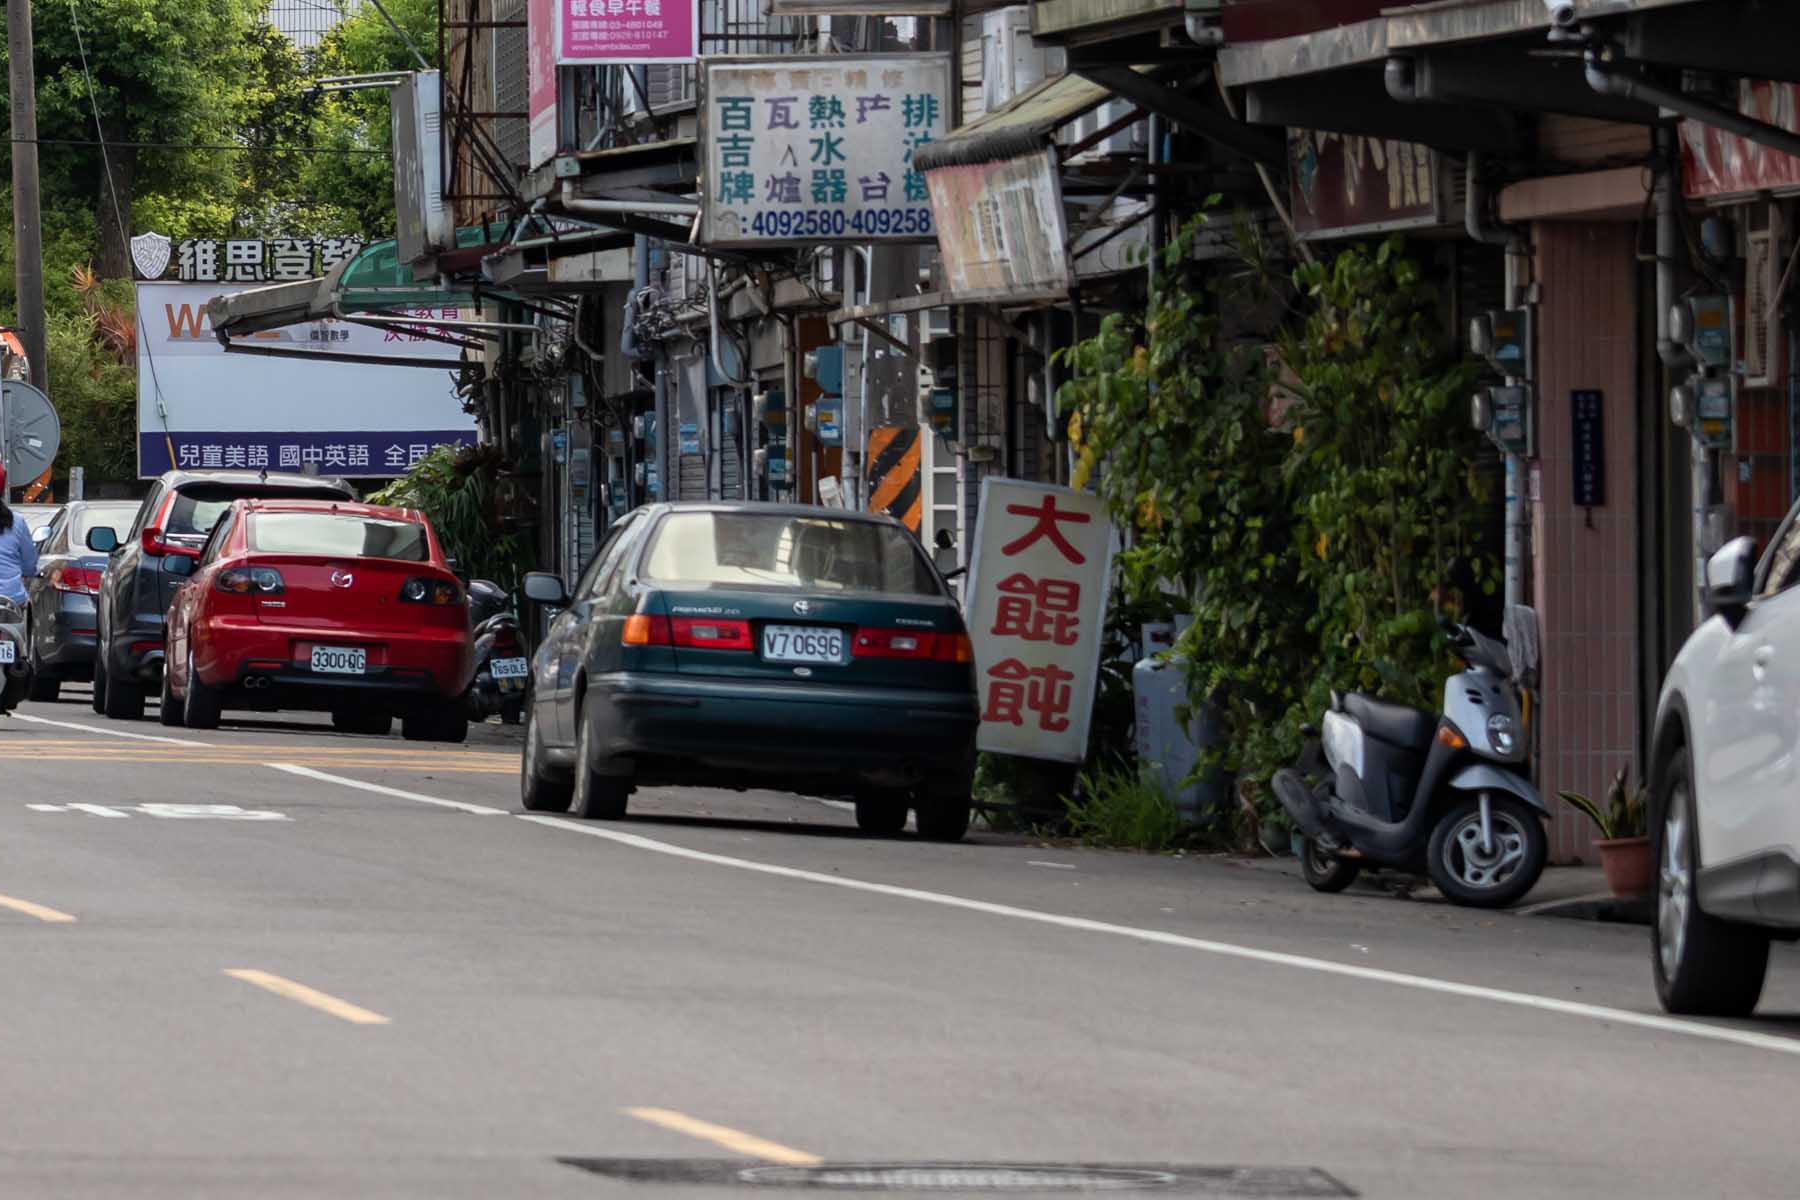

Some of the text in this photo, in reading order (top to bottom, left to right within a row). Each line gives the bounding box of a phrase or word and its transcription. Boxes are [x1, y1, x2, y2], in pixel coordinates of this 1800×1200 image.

[570, 0, 661, 17] 輕食早午餐
[715, 96, 755, 204] 百吉牌
[808, 94, 848, 204] 熱水器
[179, 443, 268, 467] 兒童美語
[279, 444, 370, 467] 國中英語
[982, 495, 1091, 733] 大餛飩
